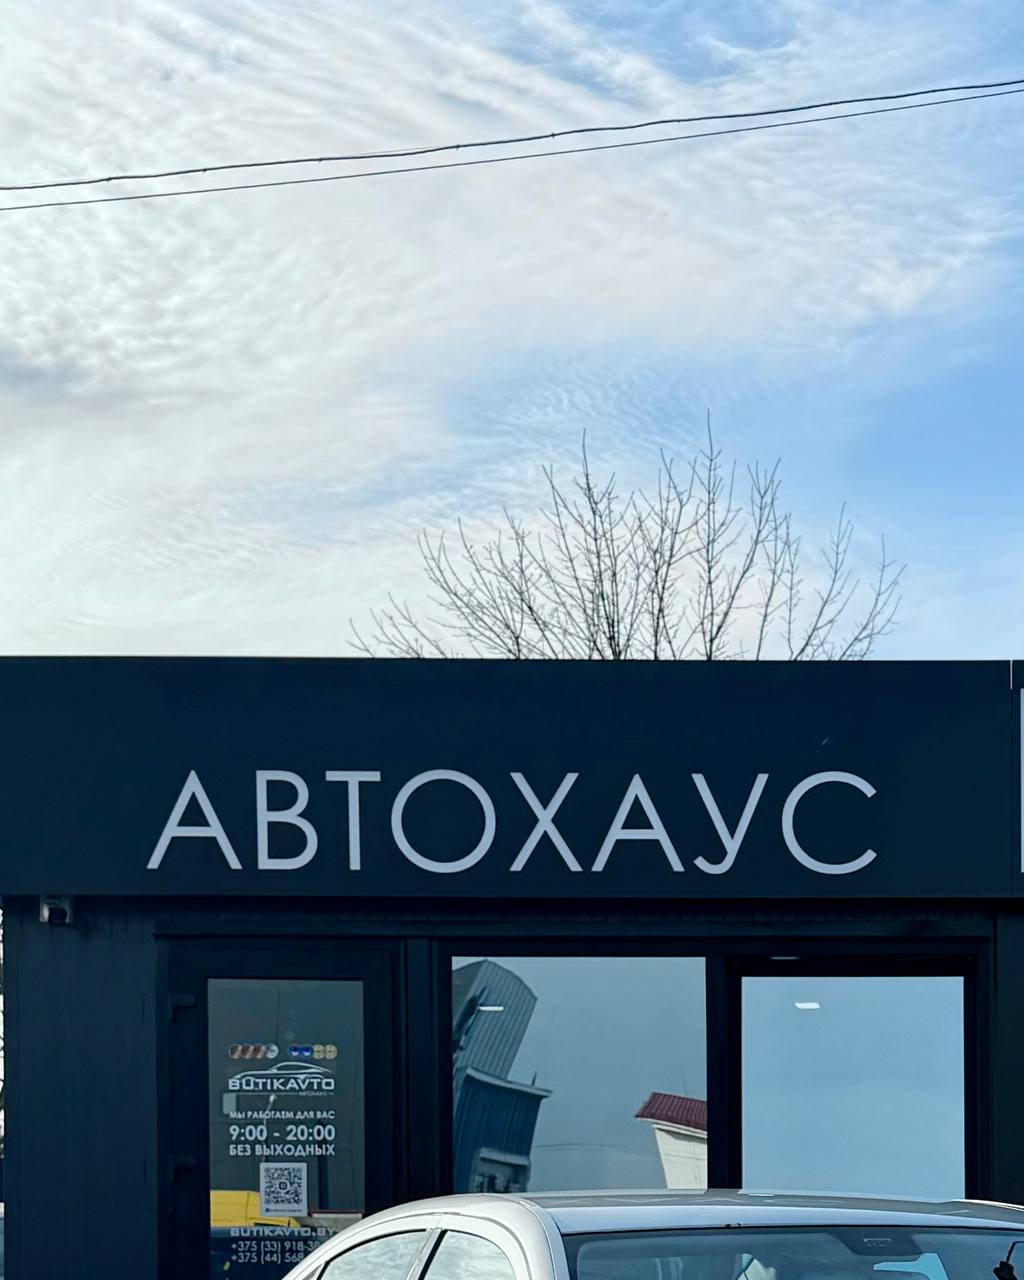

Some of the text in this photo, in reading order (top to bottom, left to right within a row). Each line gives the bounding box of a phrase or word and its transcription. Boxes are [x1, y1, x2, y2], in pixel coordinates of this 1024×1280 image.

[147, 768, 879, 875] АВТОХАУС
[228, 1078, 335, 1090] BUTIKAVTO
[247, 1111, 294, 1119] РАБОТАЕМ
[295, 1111, 315, 1120] ДЛЯ
[316, 1111, 336, 1119] ВАС
[229, 1125, 268, 1141] 9:00
[286, 1125, 336, 1141] 20:00
[229, 1144, 336, 1157] БЕЗ ВЫХОДНЫХ
[229, 1227, 336, 1237] BUTIKAVTO.BY
[231, 1241, 258, 1251] +375
[260, 1240, 282, 1253] (33)
[231, 1252, 305, 1264] +375 (44) 568
